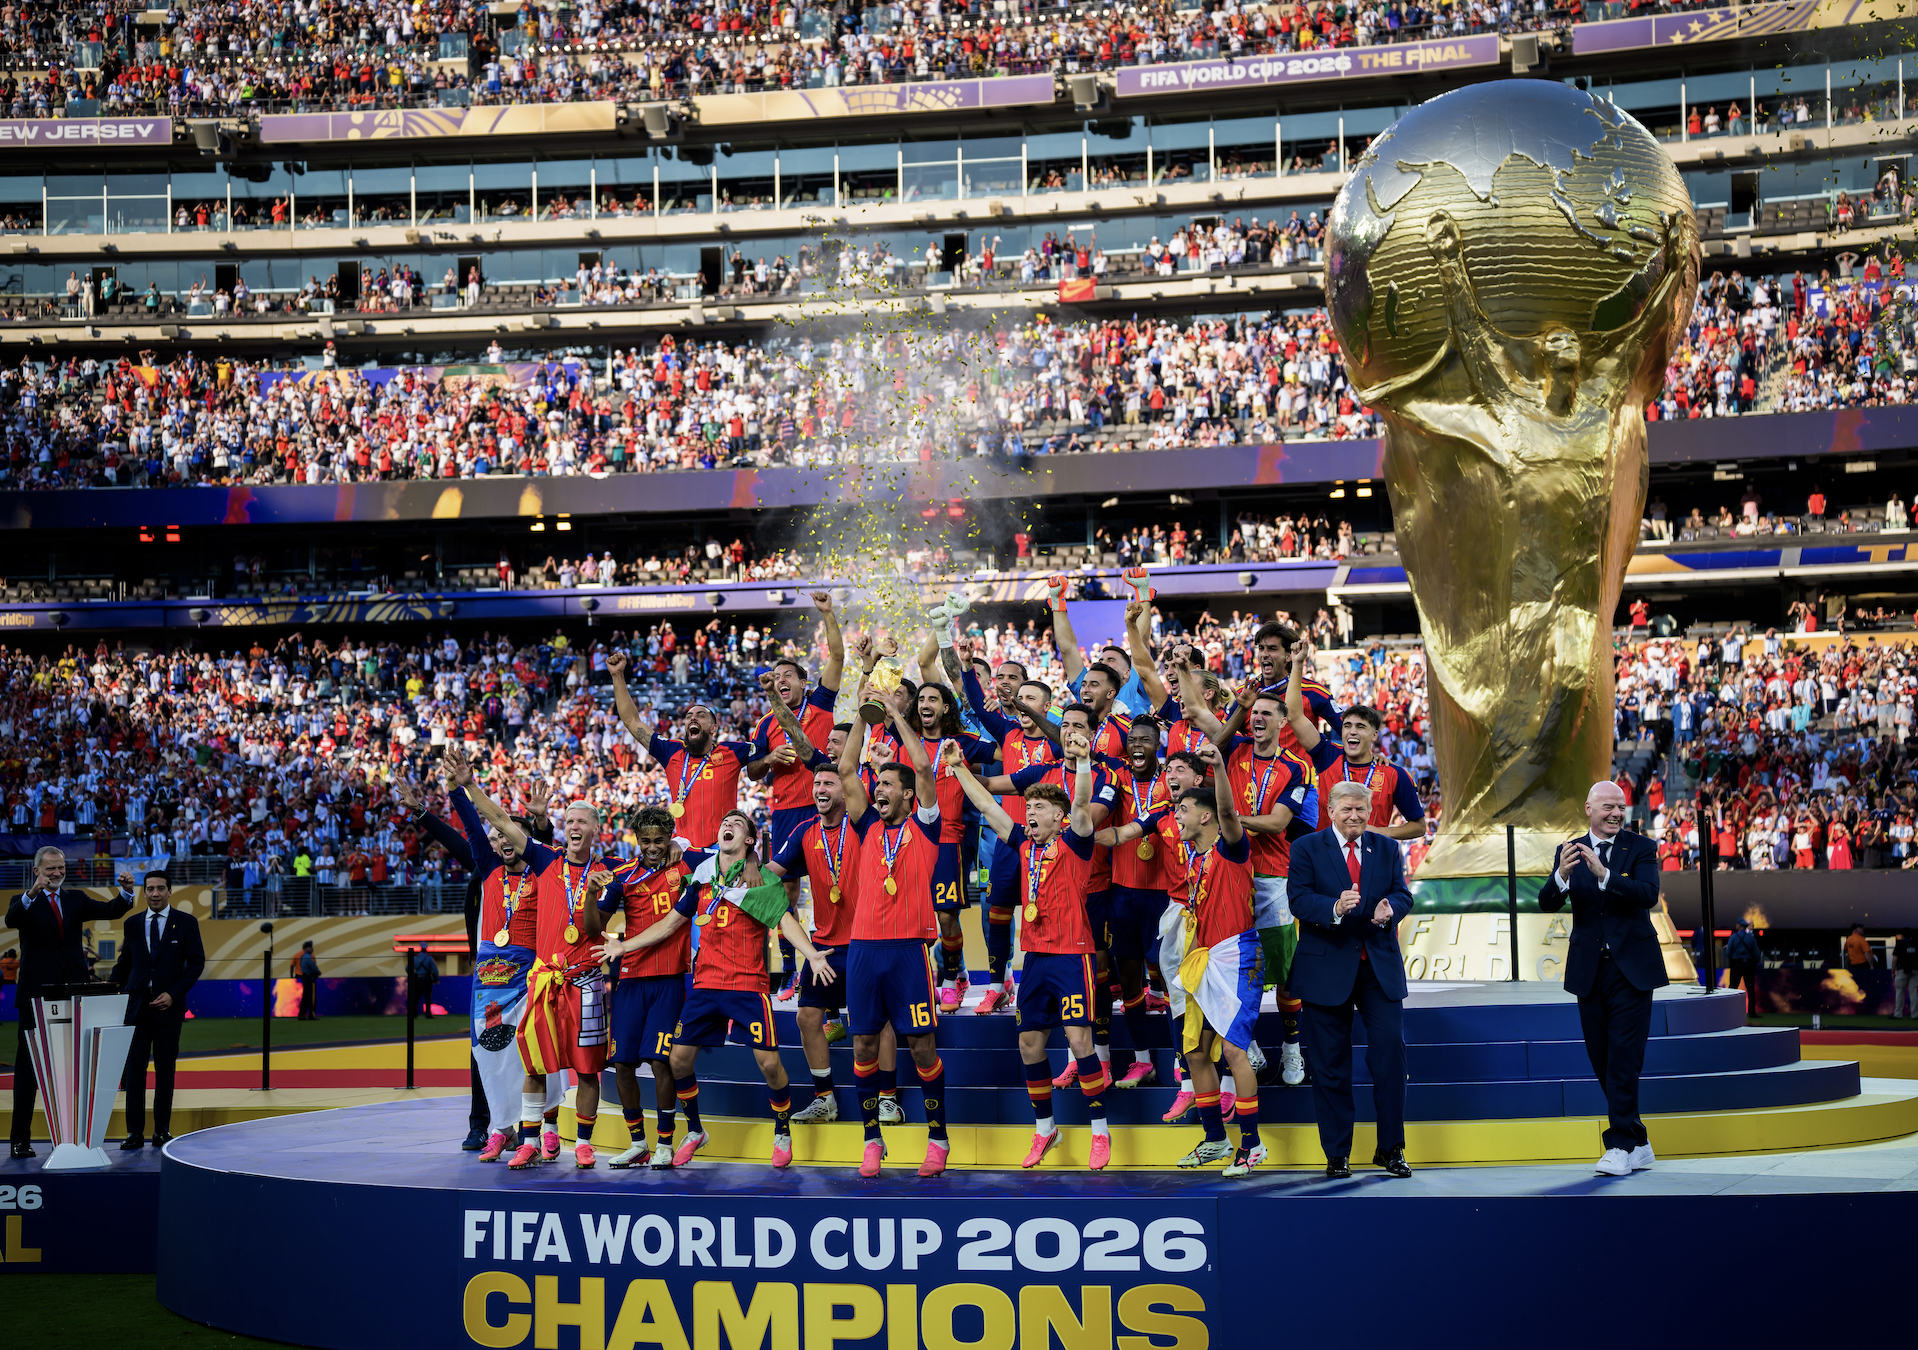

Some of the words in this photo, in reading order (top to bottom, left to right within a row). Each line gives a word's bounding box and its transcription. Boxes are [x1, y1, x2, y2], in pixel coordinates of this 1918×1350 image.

[1140, 71, 1179, 88] FIFA
[1182, 64, 1246, 85] WORLD
[1249, 61, 1285, 79] CUP
[1287, 56, 1353, 76] 2026
[1358, 51, 1403, 69] THE
[1405, 45, 1472, 66] FINAL
[45, 123, 154, 140] JERSEY
[618, 594, 695, 609] #FIFAWorldCup
[0, 612, 35, 628] rldCup
[651, 891, 672, 915] 19
[936, 881, 958, 904] 24
[717, 905, 730, 928] 9
[1408, 914, 1573, 945] FIFA
[1404, 954, 1511, 981] ORLD
[909, 1002, 931, 1027] 16
[1062, 994, 1084, 1020] 25
[750, 1021, 763, 1044] 9
[0, 1185, 43, 1210] 26
[0, 1215, 42, 1262] L
[463, 1209, 572, 1263] FIFA
[579, 1213, 797, 1268] WORLD
[809, 1216, 943, 1271] CUP
[956, 1216, 1208, 1273] 2026
[463, 1271, 1210, 1350] CHAMPIONS
